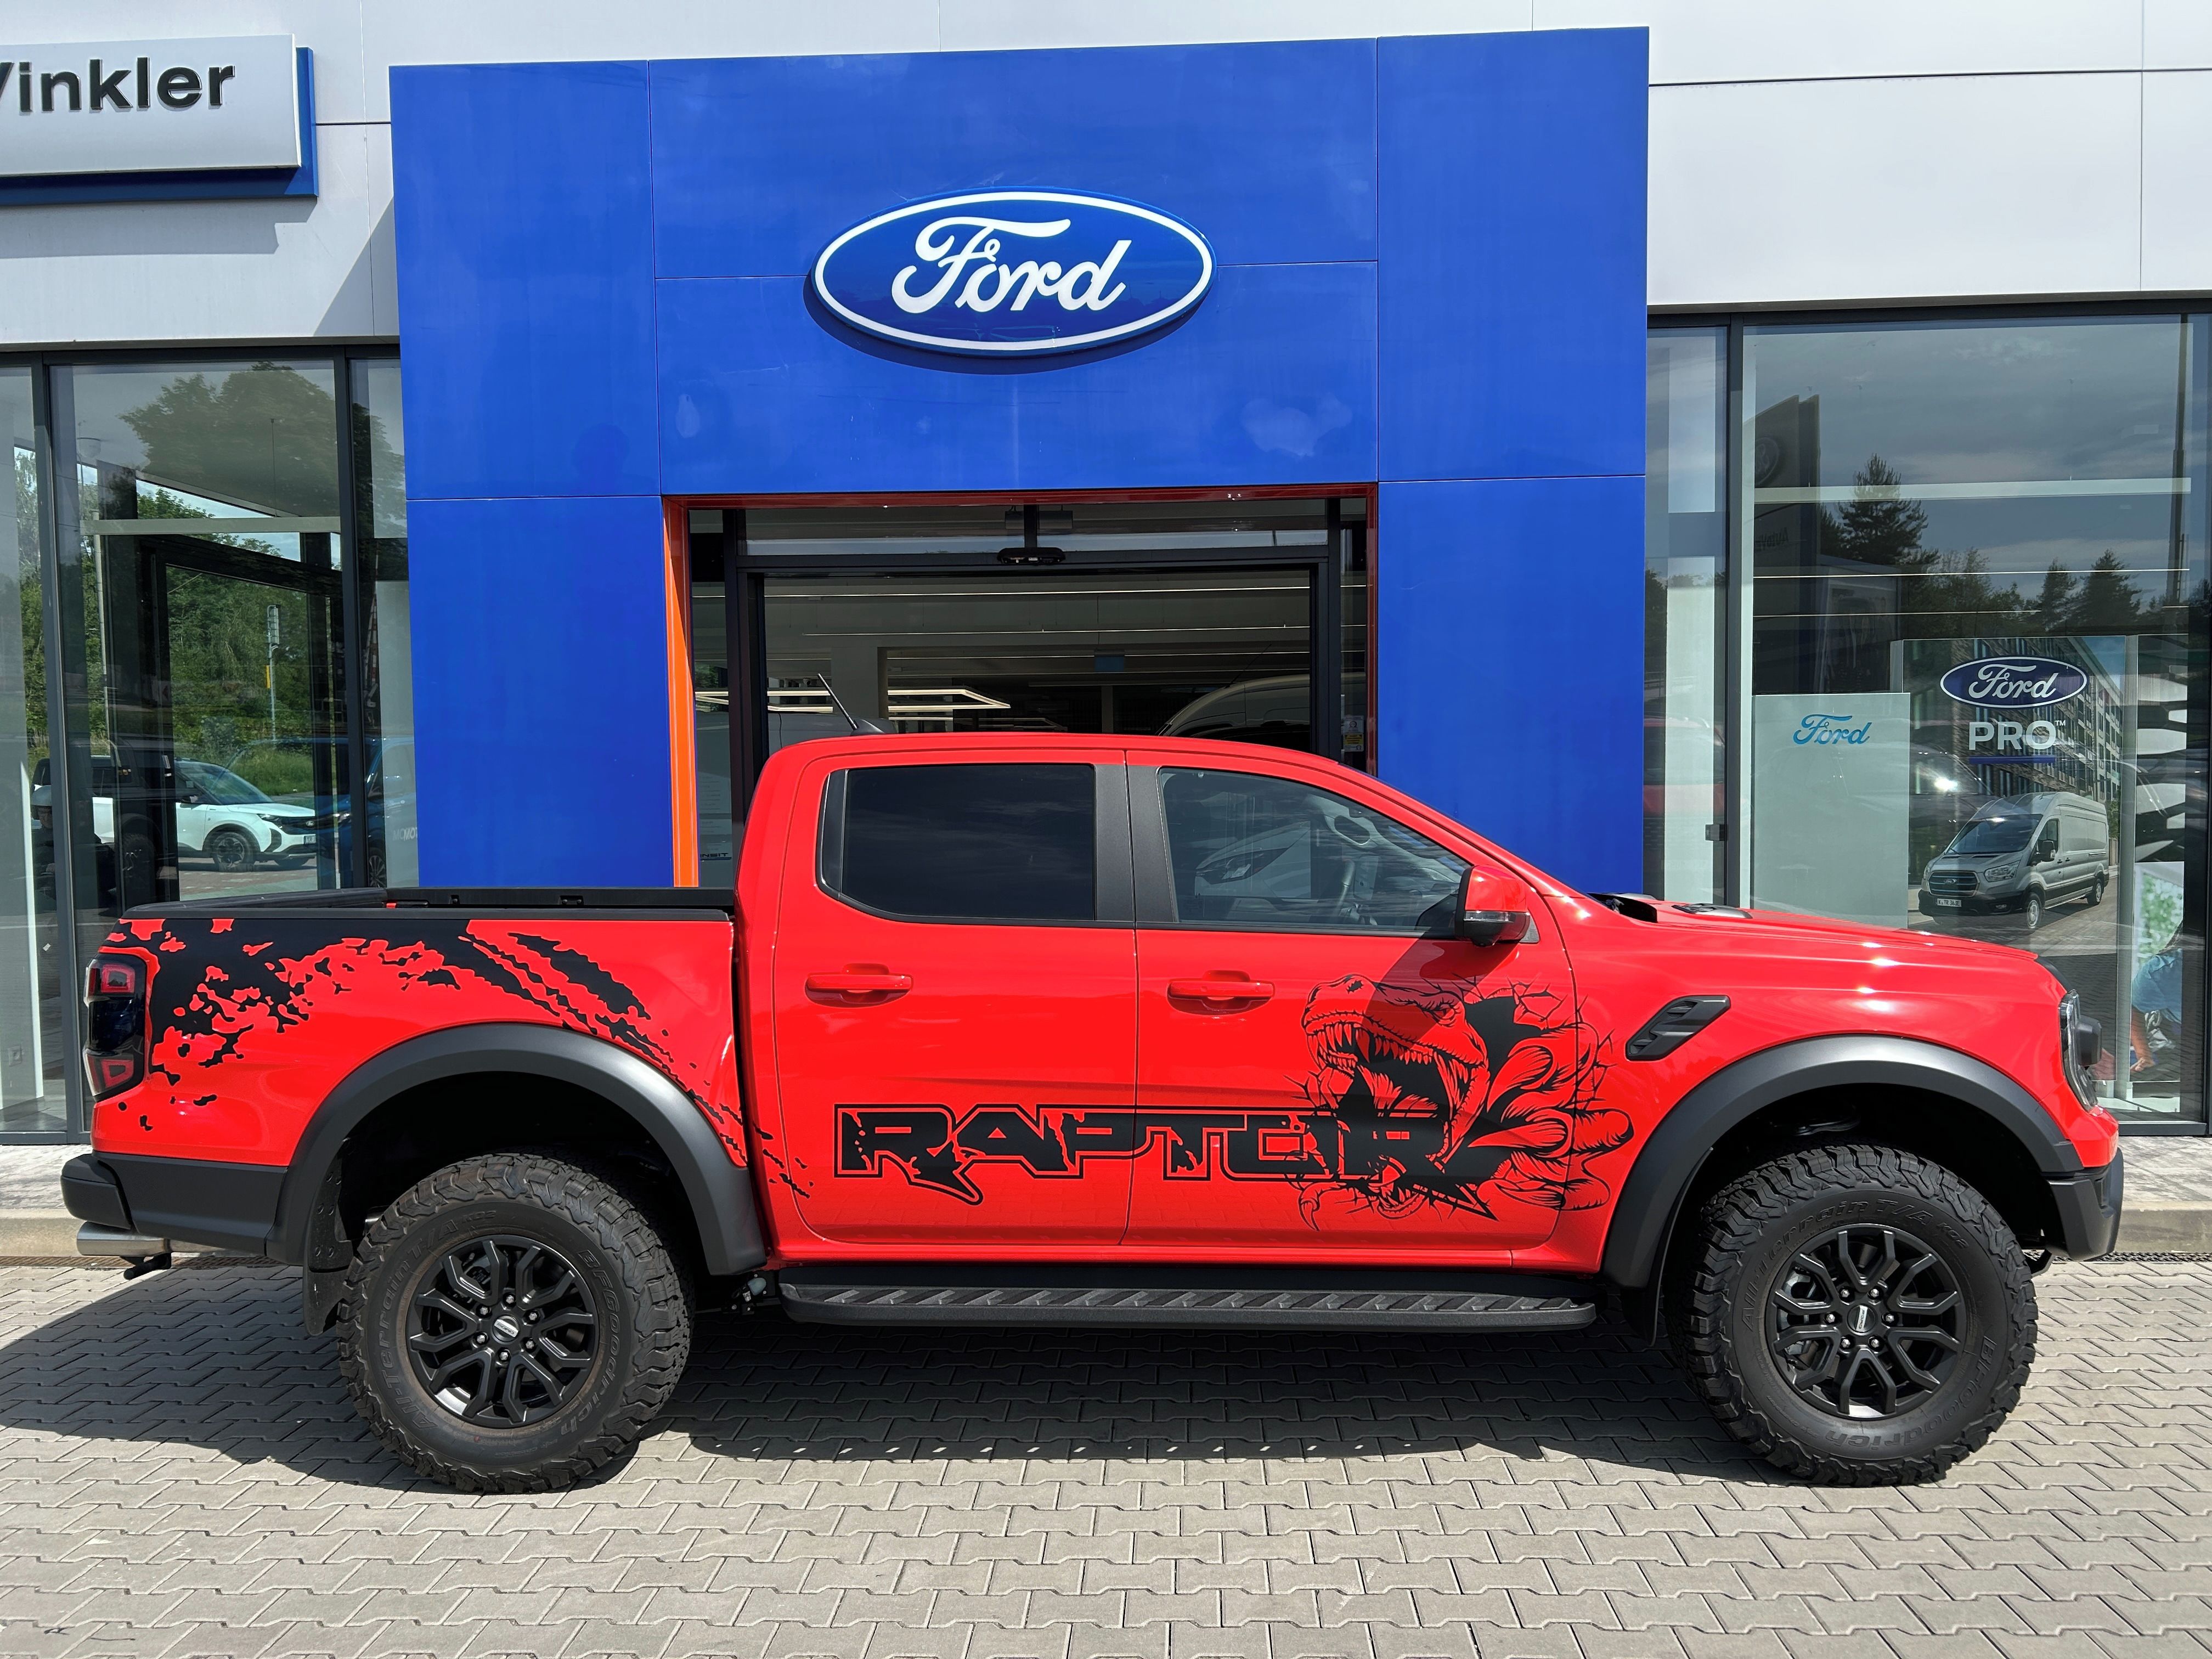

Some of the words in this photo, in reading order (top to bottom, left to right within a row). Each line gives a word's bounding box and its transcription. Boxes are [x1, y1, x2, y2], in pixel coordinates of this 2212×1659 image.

[0, 57, 235, 112] inkler
[891, 216, 1132, 313] Ford
[1793, 714, 1872, 744] Ford
[1968, 664, 2059, 698] Ford
[834, 1103, 1499, 1221] RAPTOR
[407, 1218, 459, 1259] T/A
[1742, 1200, 1869, 1333] All-Terrain
[1876, 1199, 1934, 1225] T/A
[379, 1260, 438, 1429] All-Terrain
[561, 1250, 620, 1436] BFGoodrich
[1825, 1336, 1998, 1450] BFGoodrich
